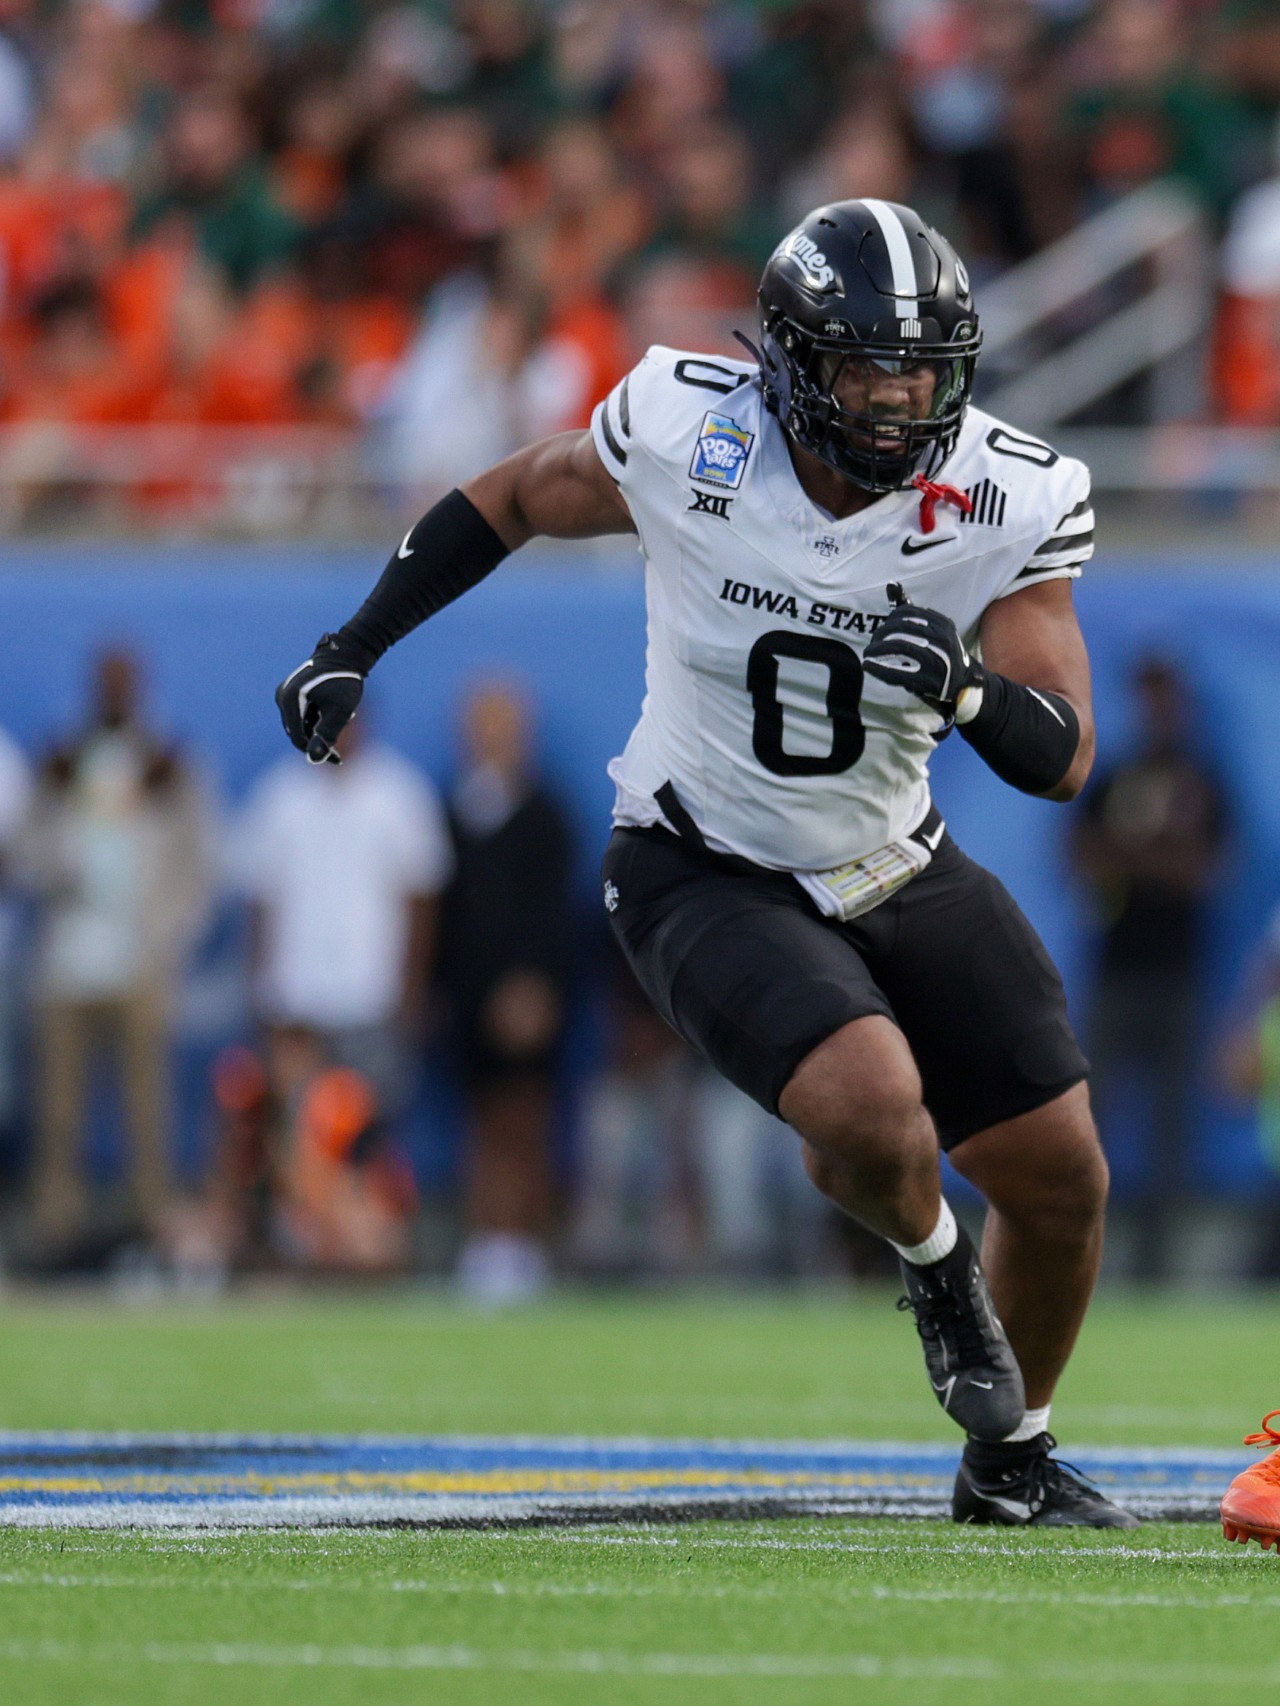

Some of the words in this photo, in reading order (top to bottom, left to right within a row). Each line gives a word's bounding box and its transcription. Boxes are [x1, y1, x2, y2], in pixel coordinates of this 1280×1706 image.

[674, 359, 750, 394] 0
[985, 428, 1060, 468] 0
[688, 487, 734, 521] XII
[719, 579, 799, 618] IOWA
[807, 602, 888, 634] STAT
[746, 630, 866, 778] 0
